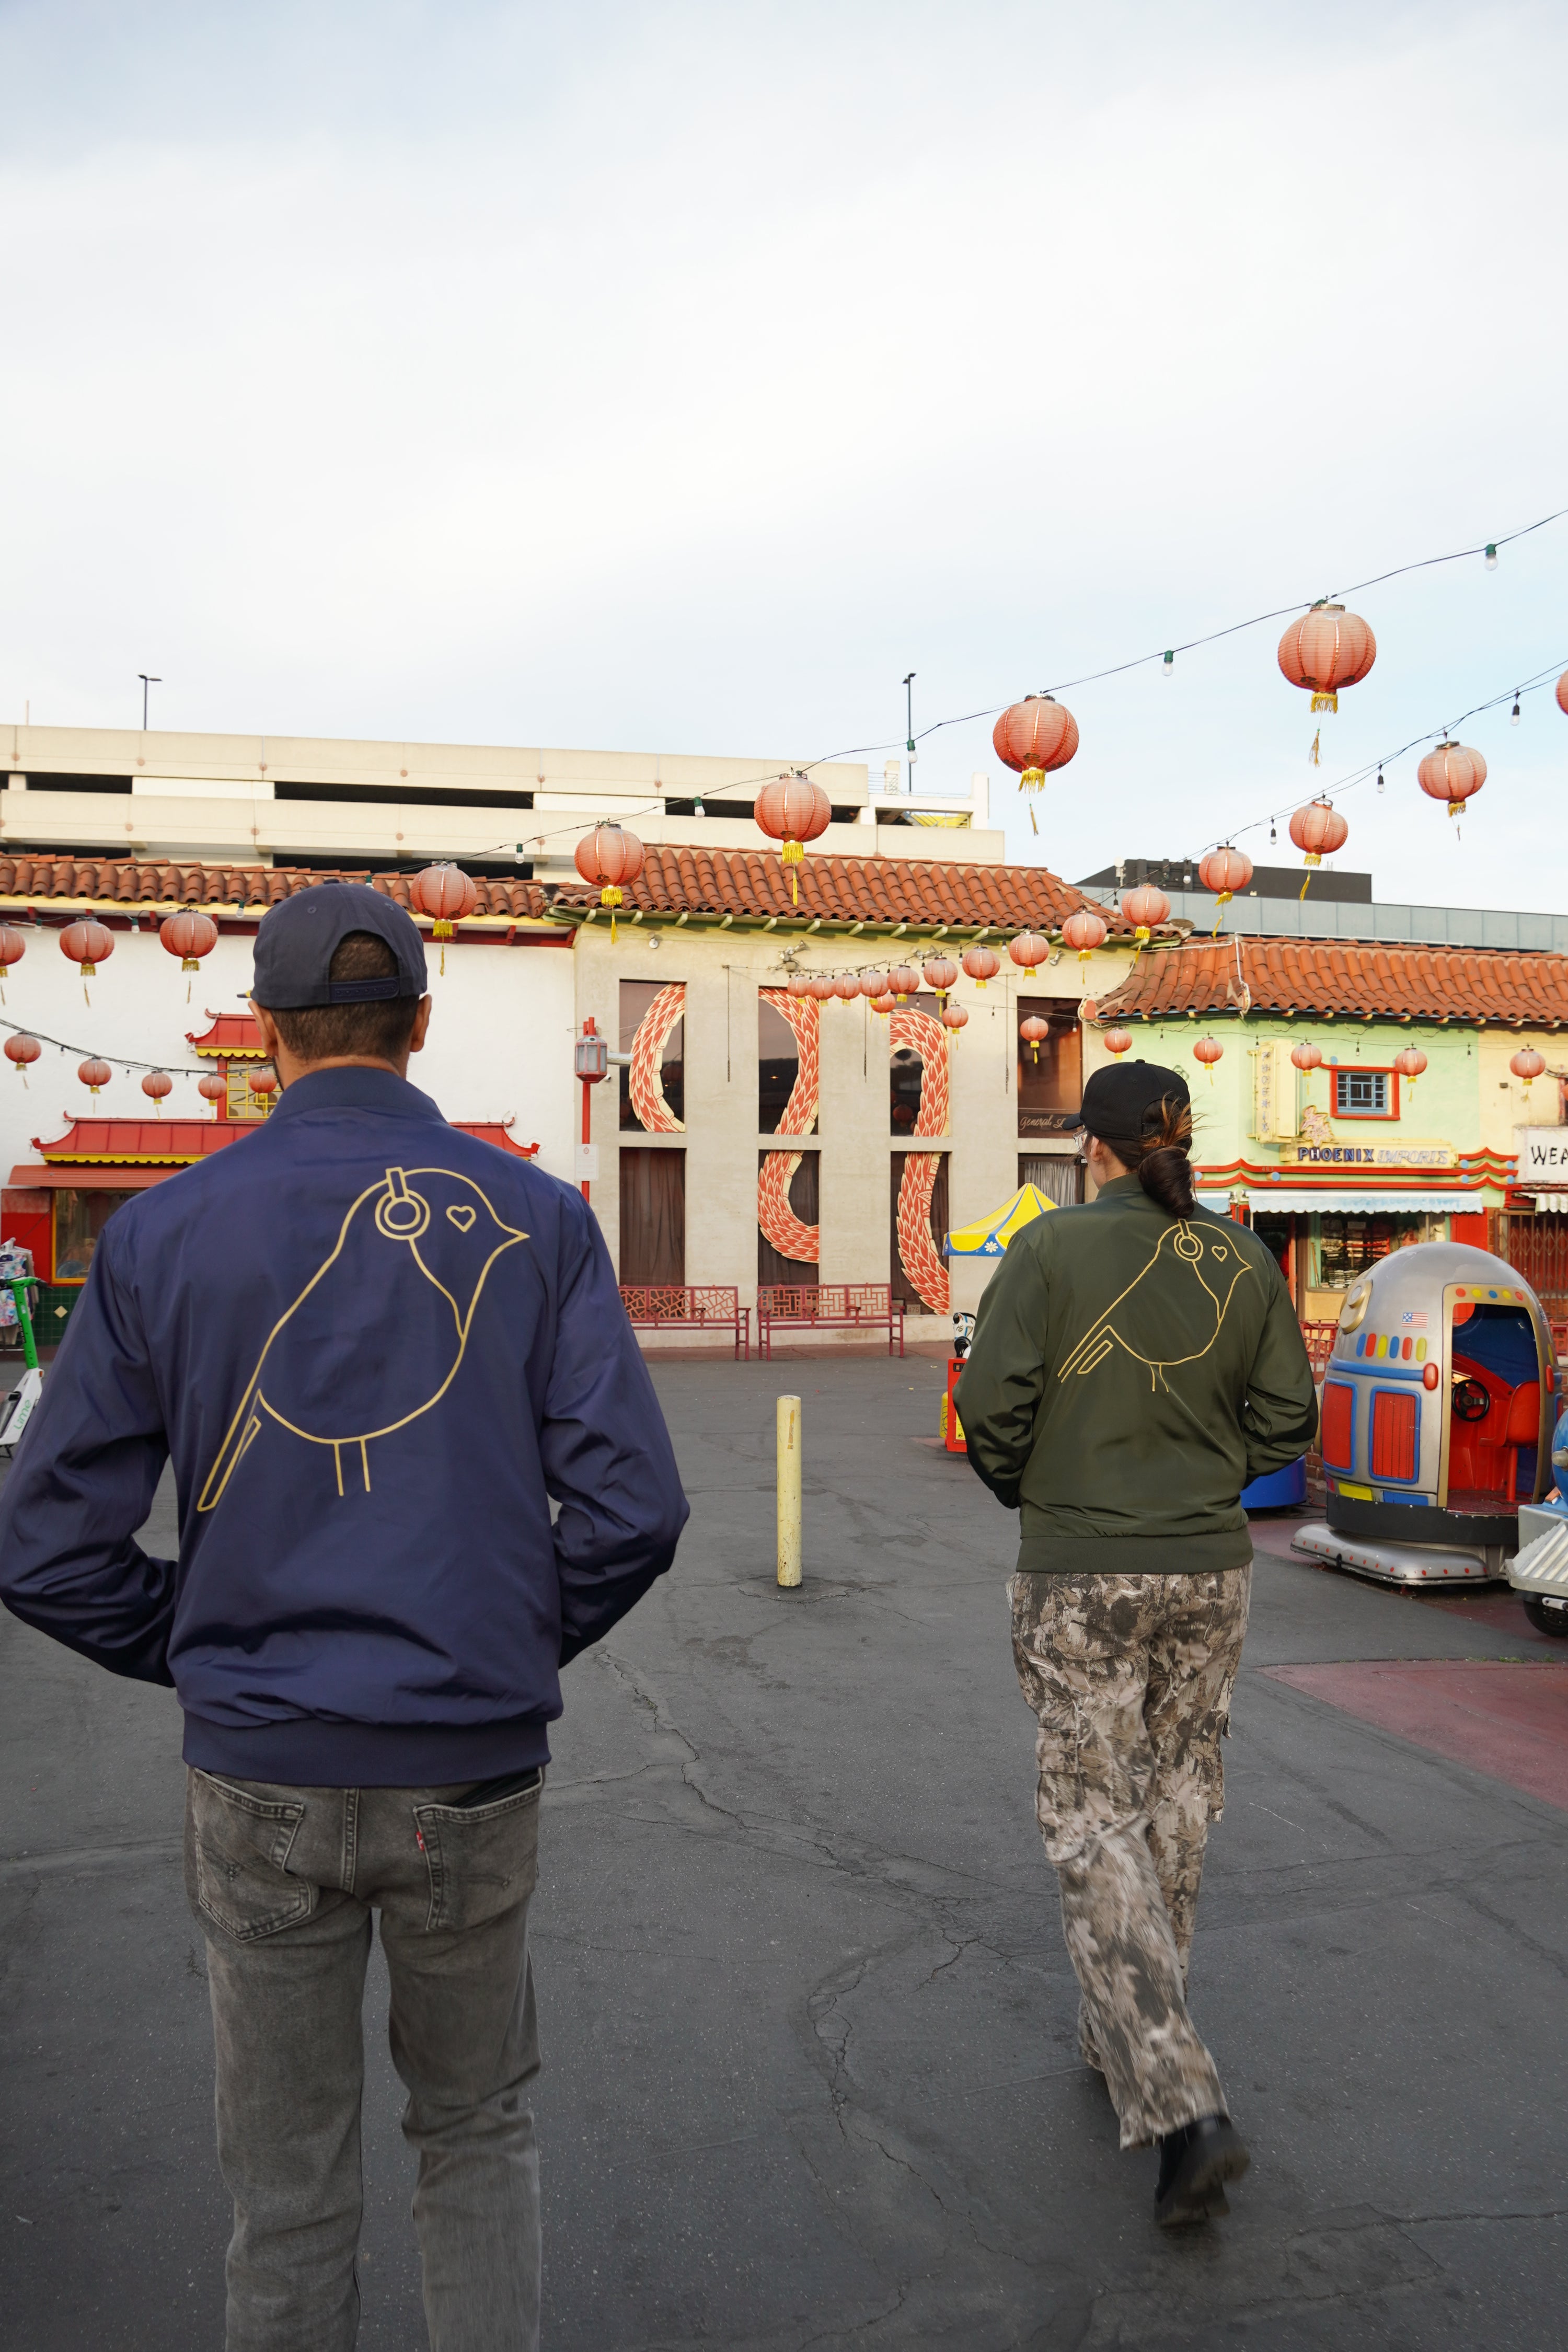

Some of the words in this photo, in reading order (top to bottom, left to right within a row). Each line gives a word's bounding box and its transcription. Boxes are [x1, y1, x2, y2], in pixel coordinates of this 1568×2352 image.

[1019, 1114, 1053, 1130] General
[1297, 1147, 1375, 1162] PHOENIX
[1377, 1150, 1448, 1164] IMPORTS
[14, 1400, 31, 1429] Lime
